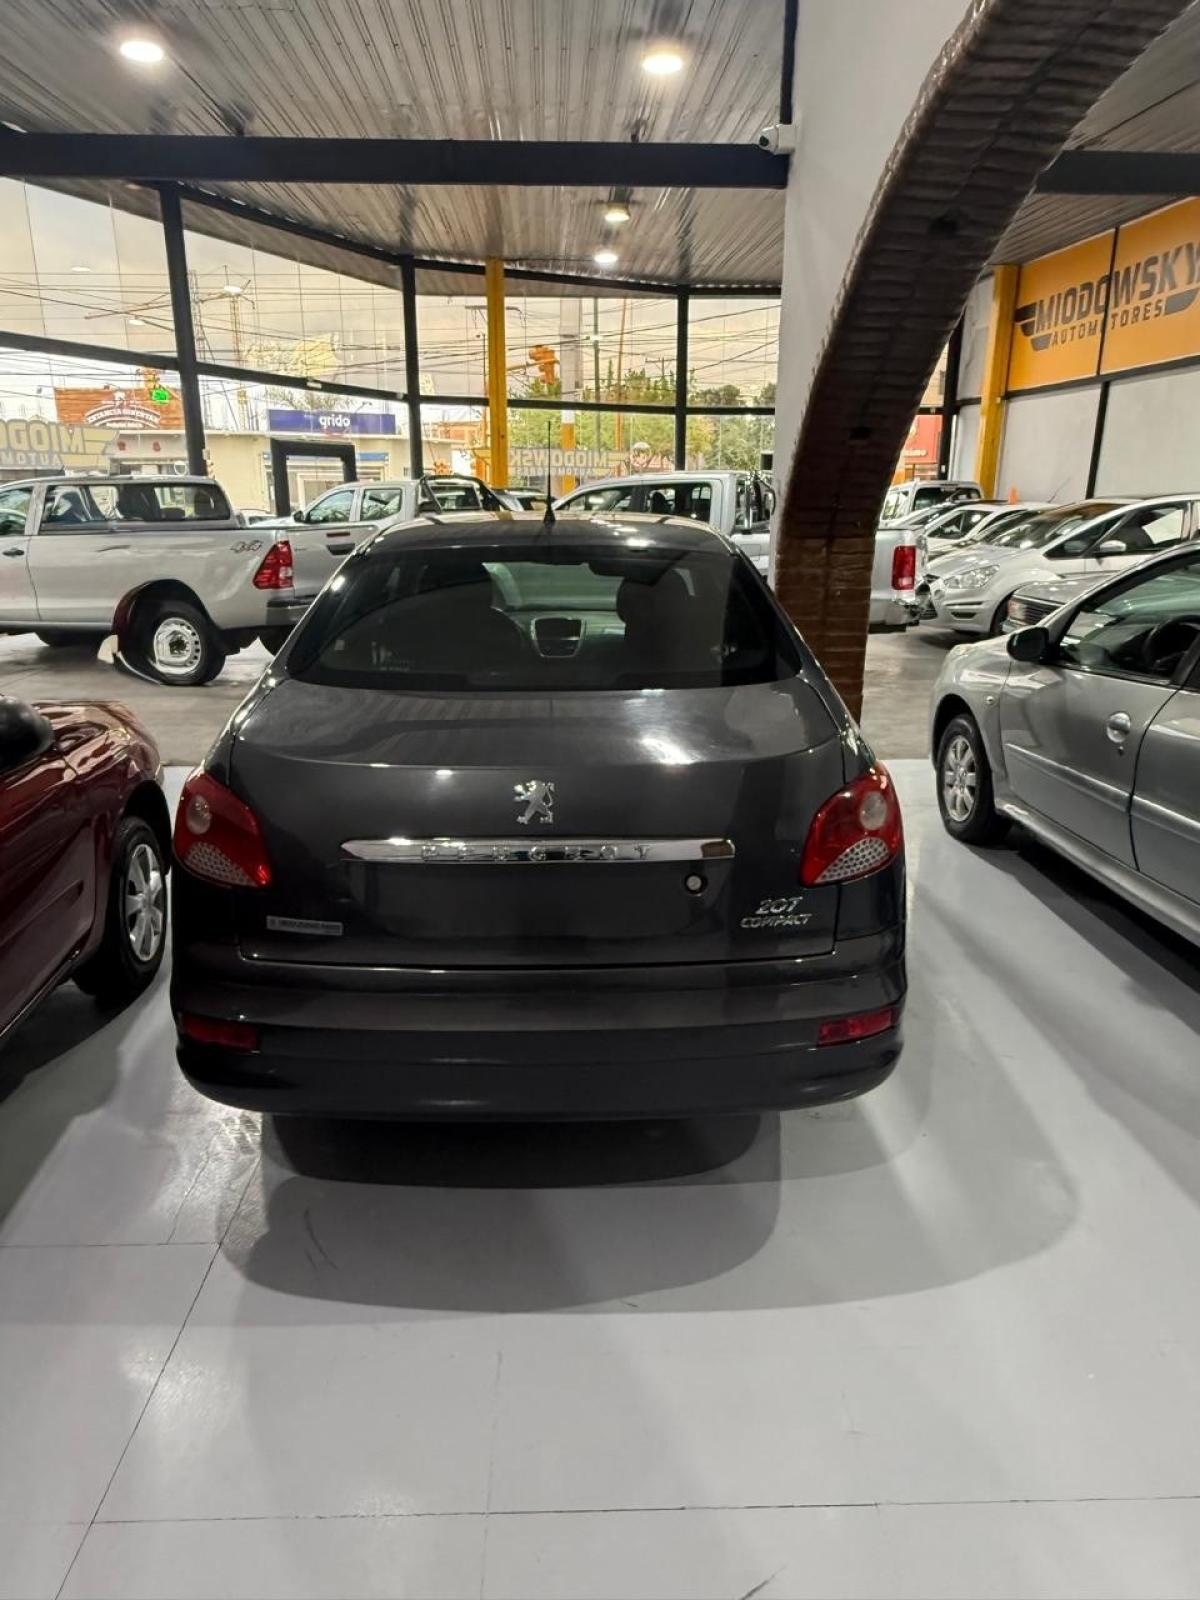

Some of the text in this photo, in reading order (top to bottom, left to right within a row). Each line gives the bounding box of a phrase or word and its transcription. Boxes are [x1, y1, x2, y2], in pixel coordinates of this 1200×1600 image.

[1049, 299, 1165, 347] AUTOMTORES
[421, 842, 650, 861] PEUGEOT
[755, 896, 803, 915] 207
[740, 913, 813, 928] COMPACT
